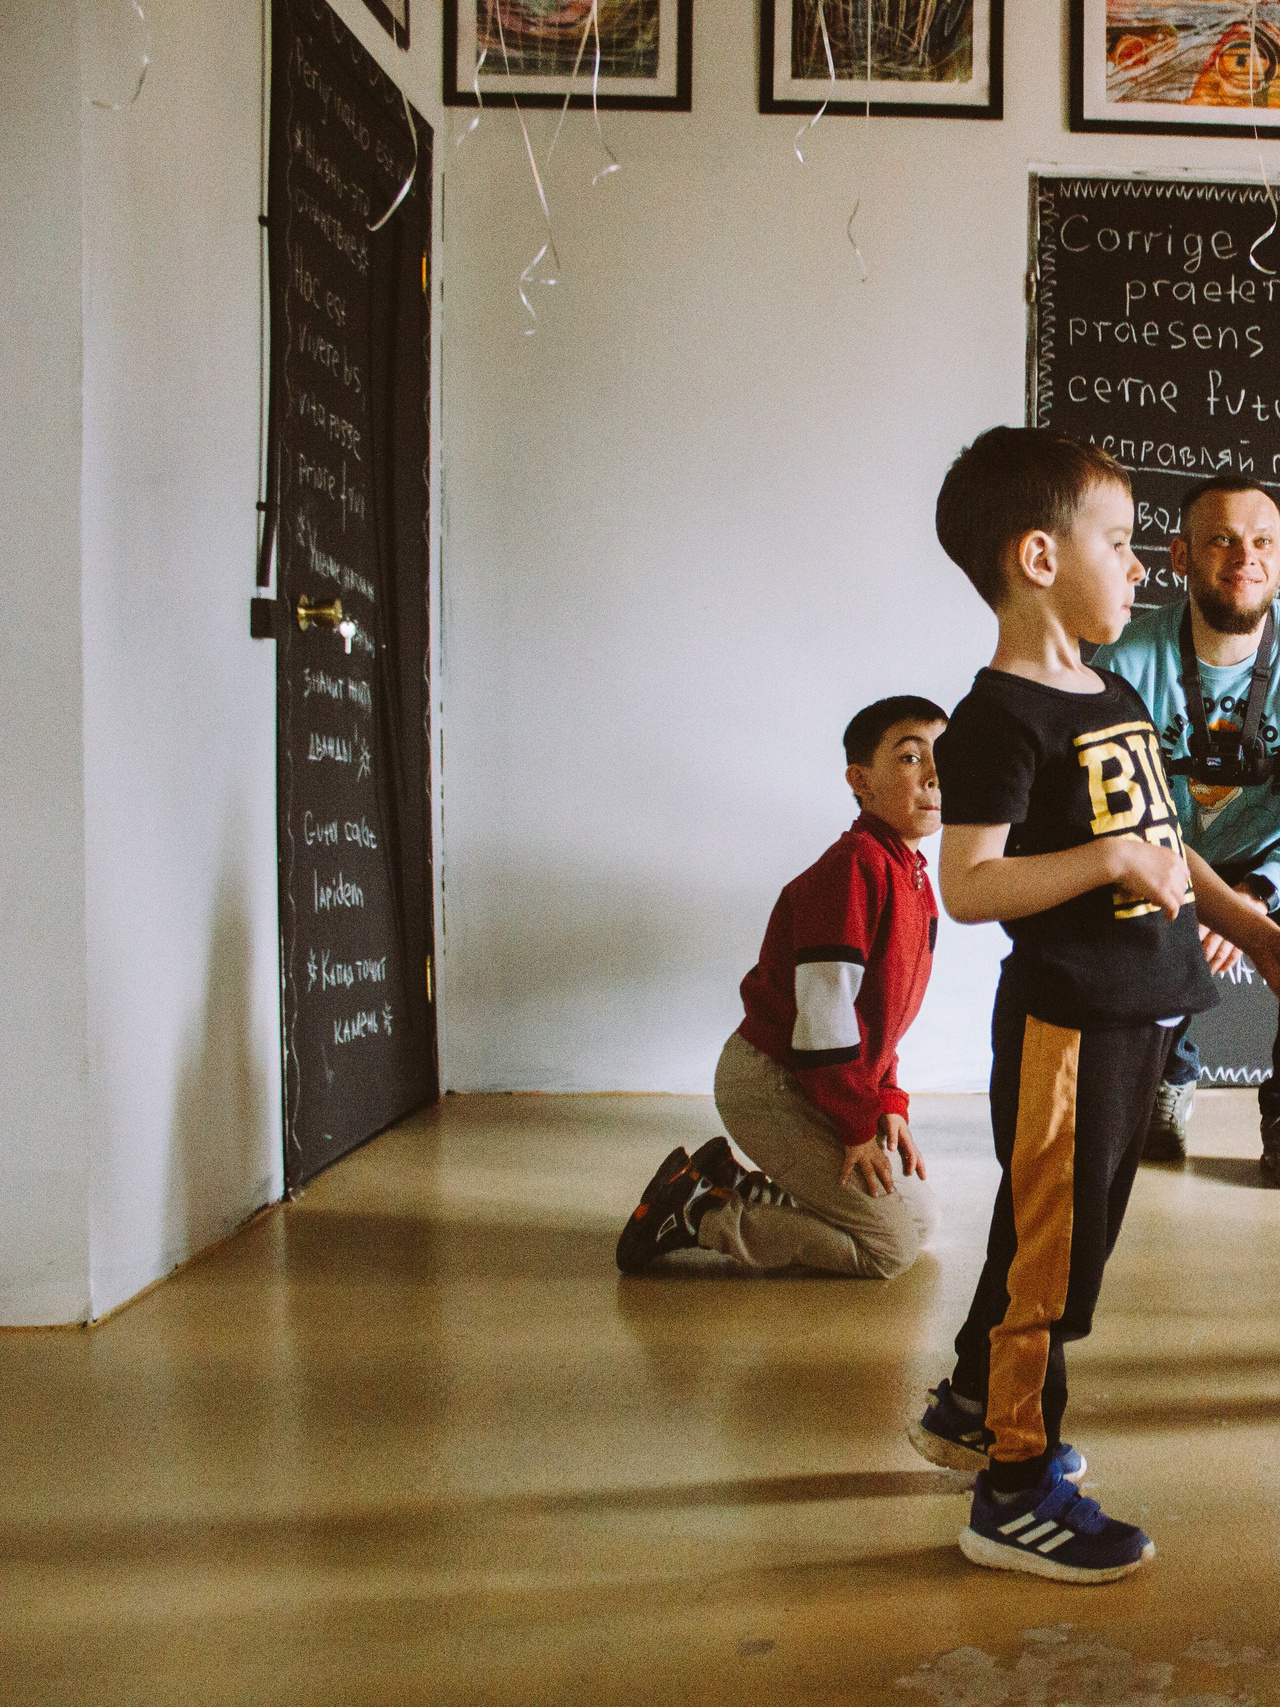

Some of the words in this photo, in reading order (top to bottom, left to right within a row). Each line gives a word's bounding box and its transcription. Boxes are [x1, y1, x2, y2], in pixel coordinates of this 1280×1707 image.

[1061, 214, 1238, 273] Corrige
[1069, 317, 1264, 358] praesens
[1068, 375, 1178, 413] cerne
